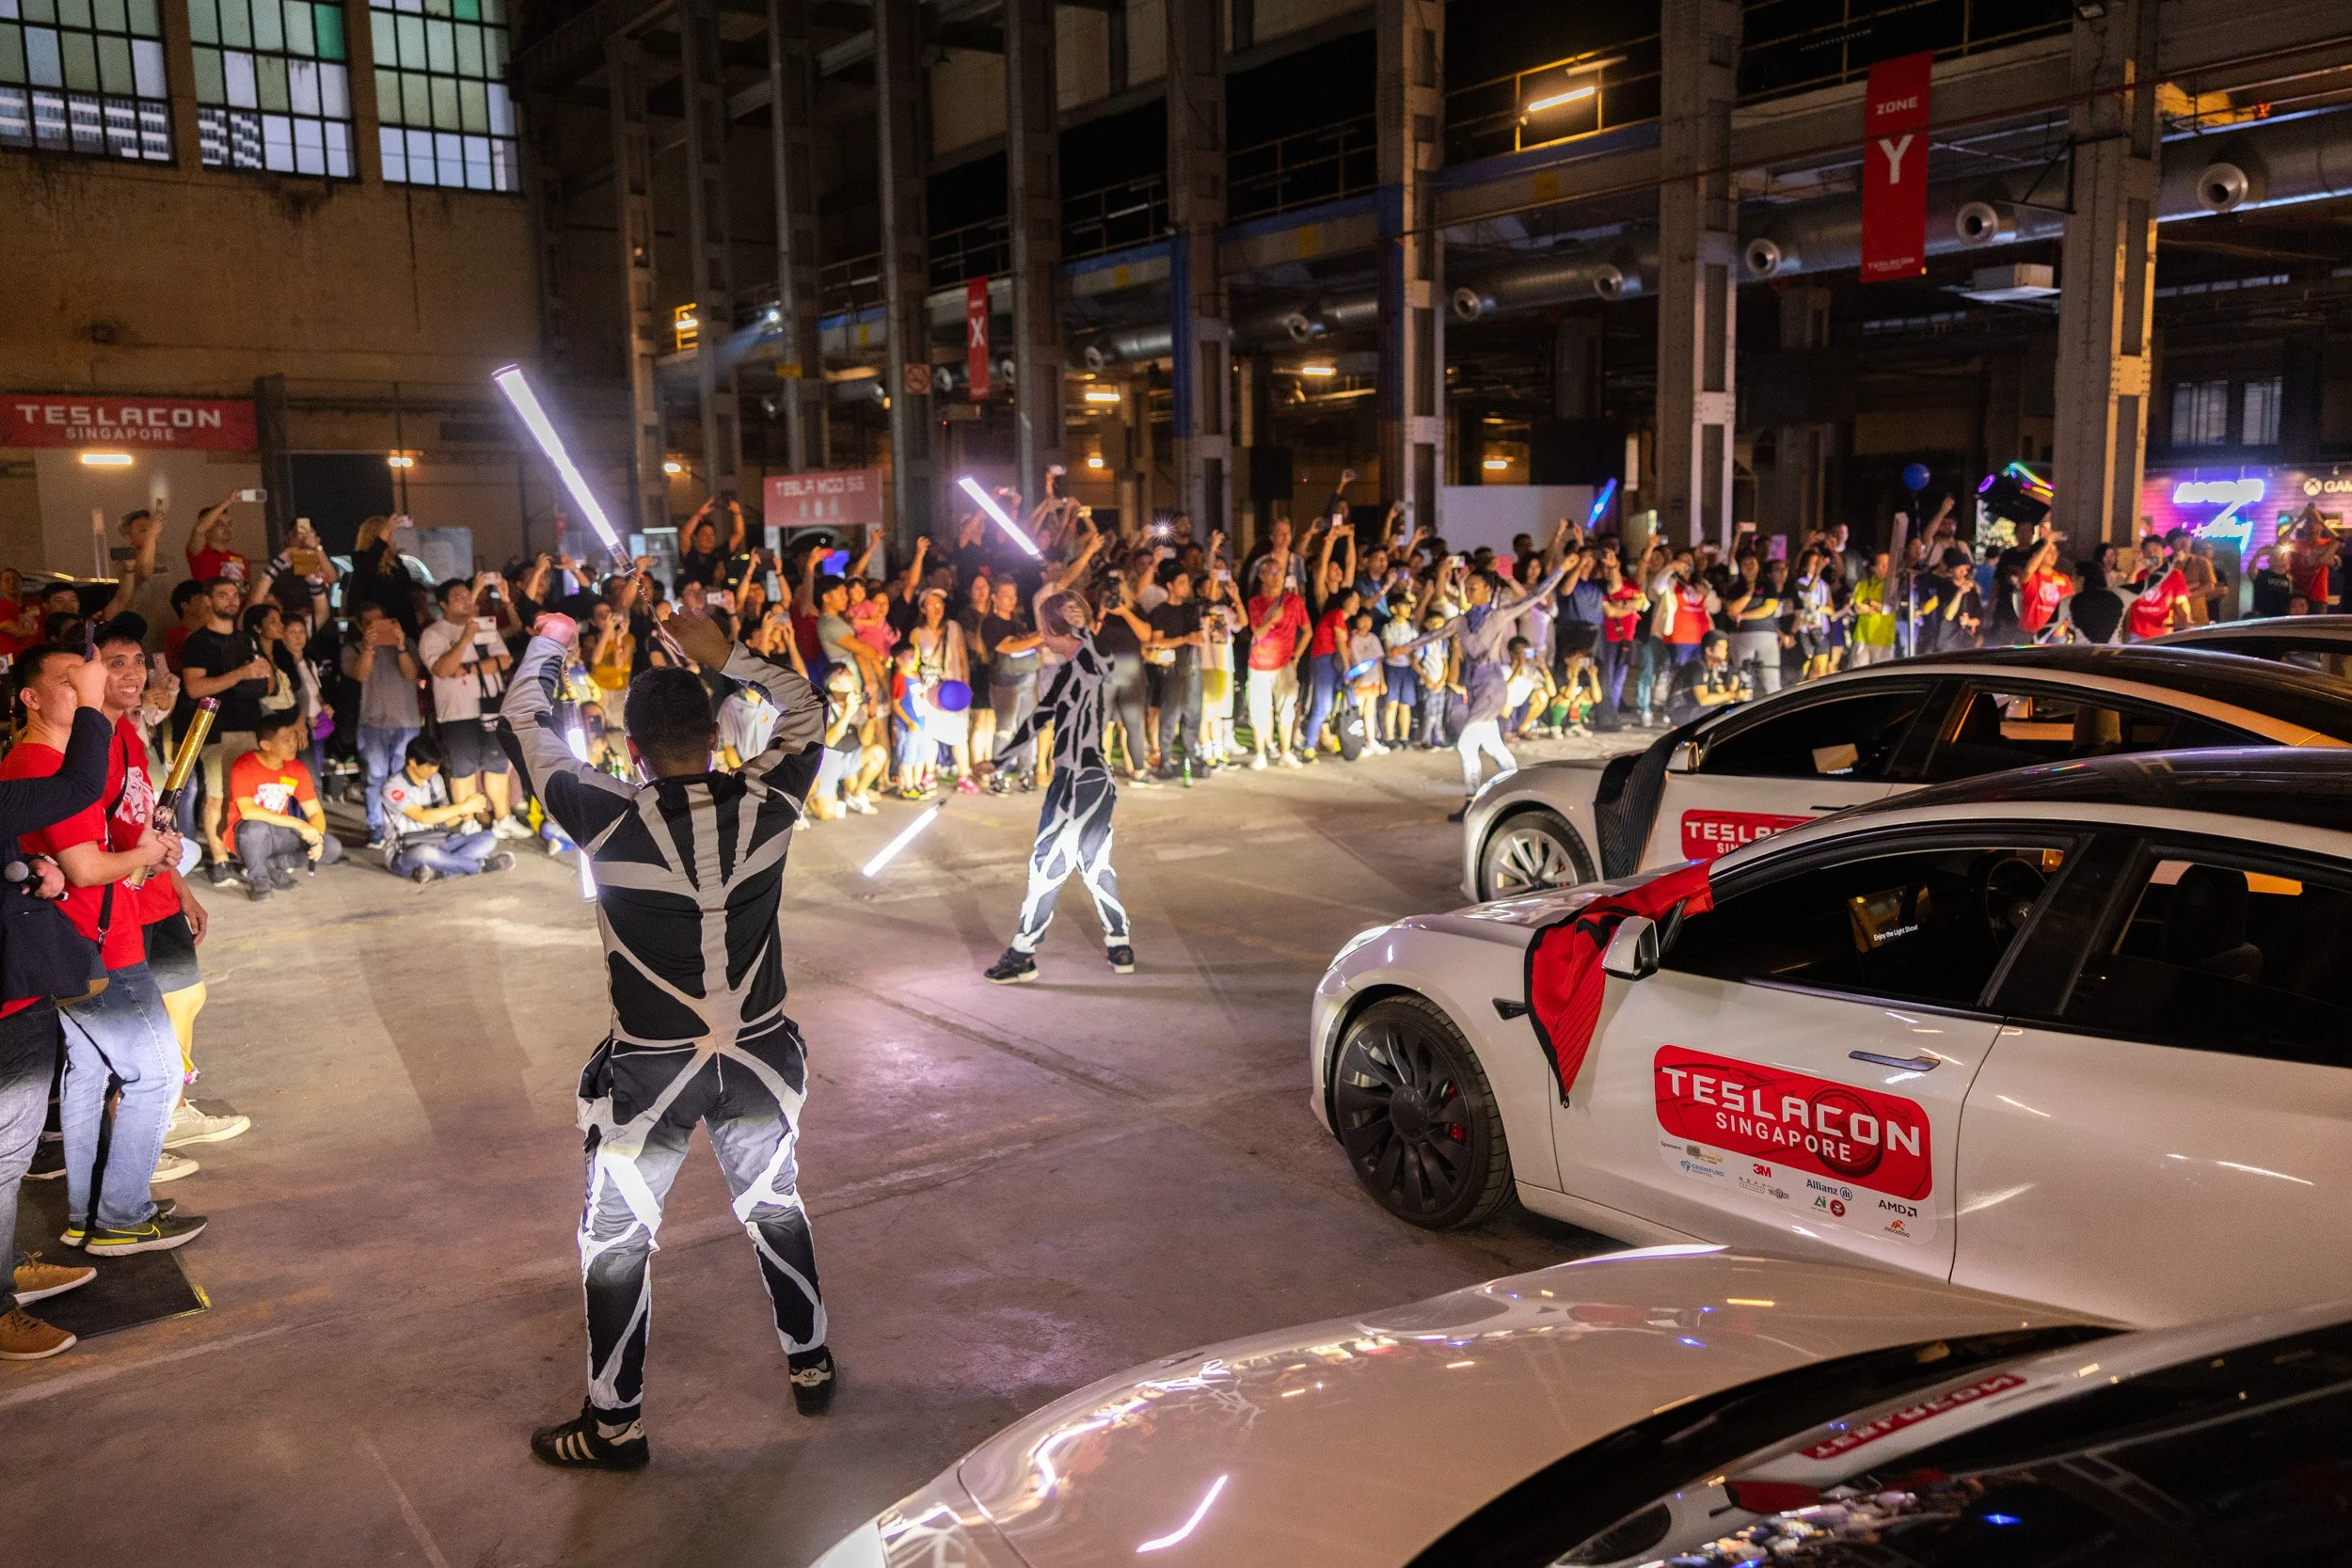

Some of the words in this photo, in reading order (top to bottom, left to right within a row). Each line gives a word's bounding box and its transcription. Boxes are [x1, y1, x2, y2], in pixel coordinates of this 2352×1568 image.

[1875, 96, 1918, 116] ZONE
[1878, 135, 1915, 185] Y
[970, 315, 986, 349] X
[16, 404, 222, 429] TESLACON
[65, 427, 176, 442] SINGAPORE
[1873, 933, 1886, 942] Enjoy
[1893, 927, 1905, 937] Light
[1661, 1067, 1920, 1157] TESLACON
[1715, 1112, 1851, 1163] SINGAPORE
[1753, 1163, 1772, 1179] 3M
[1806, 1179, 1838, 1196] Allianz
[1878, 1199, 1907, 1214] AMD
[1884, 1227, 1911, 1238] moomoo
